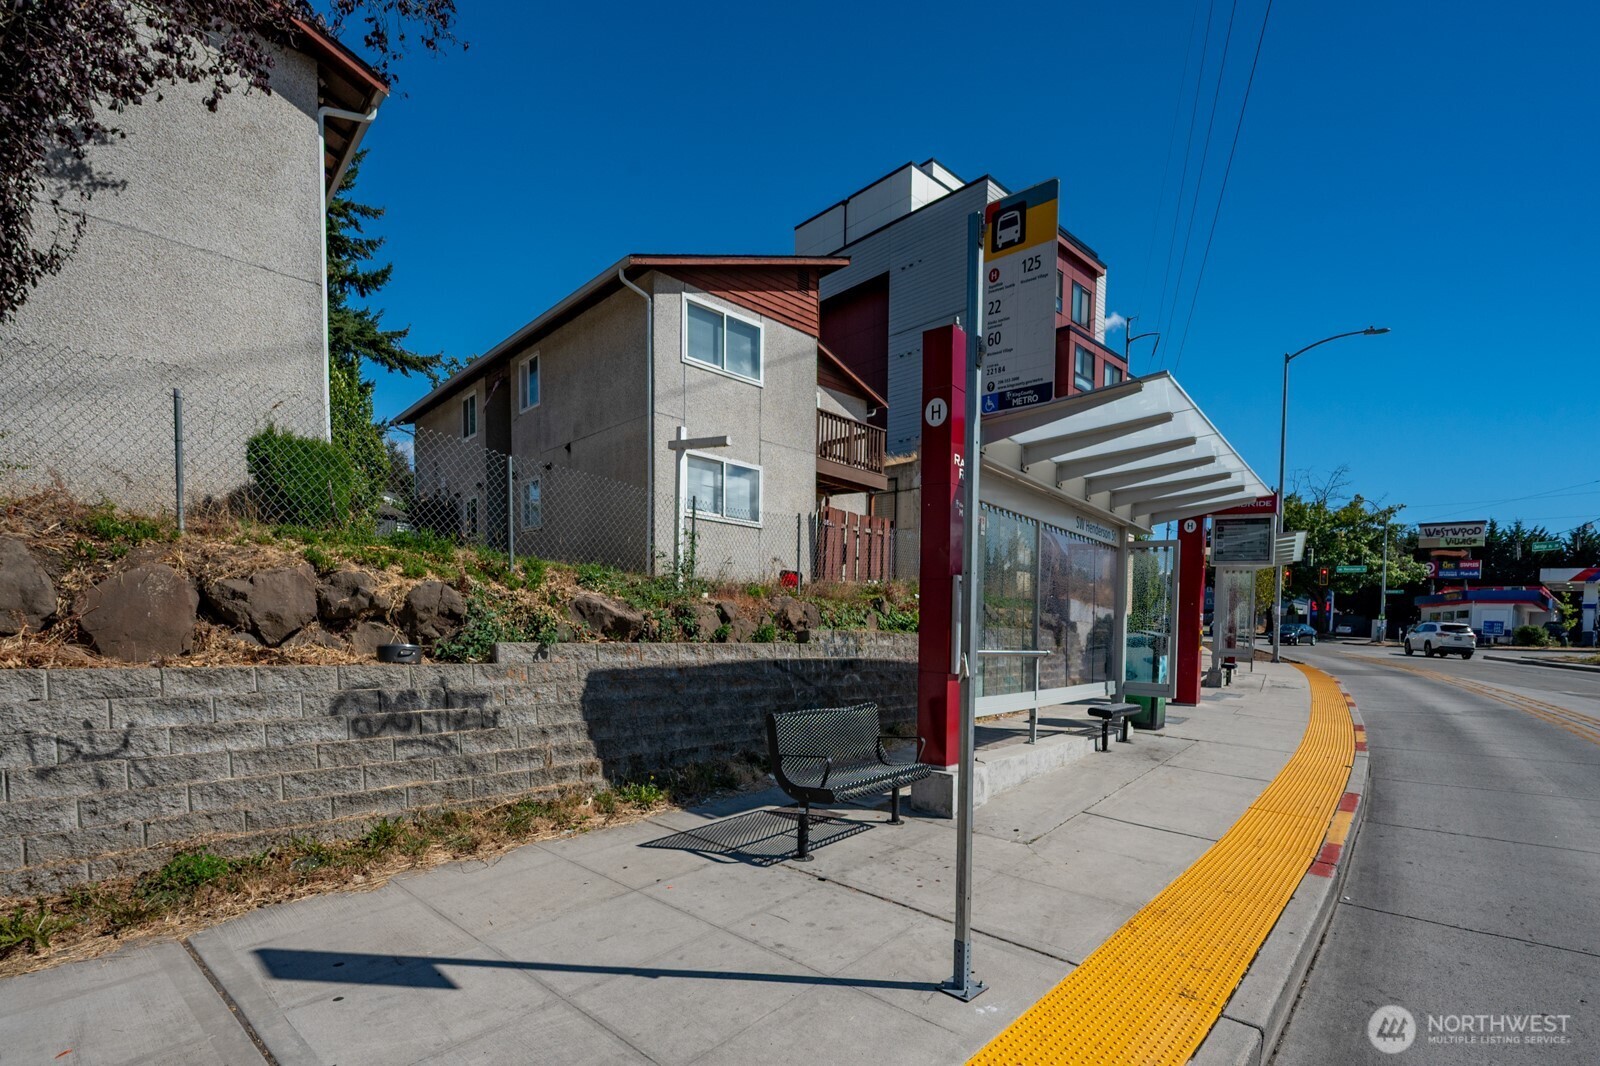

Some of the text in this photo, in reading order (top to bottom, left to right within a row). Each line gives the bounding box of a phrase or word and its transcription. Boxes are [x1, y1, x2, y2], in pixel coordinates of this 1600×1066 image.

[1022, 254, 1041, 273] 125
[988, 299, 1001, 316] 22
[987, 331, 1001, 347] 60
[986, 365, 1006, 376] 22184
[1012, 394, 1039, 406] METRO
[1076, 515, 1085, 530] SW
[1086, 520, 1111, 539] Henderson
